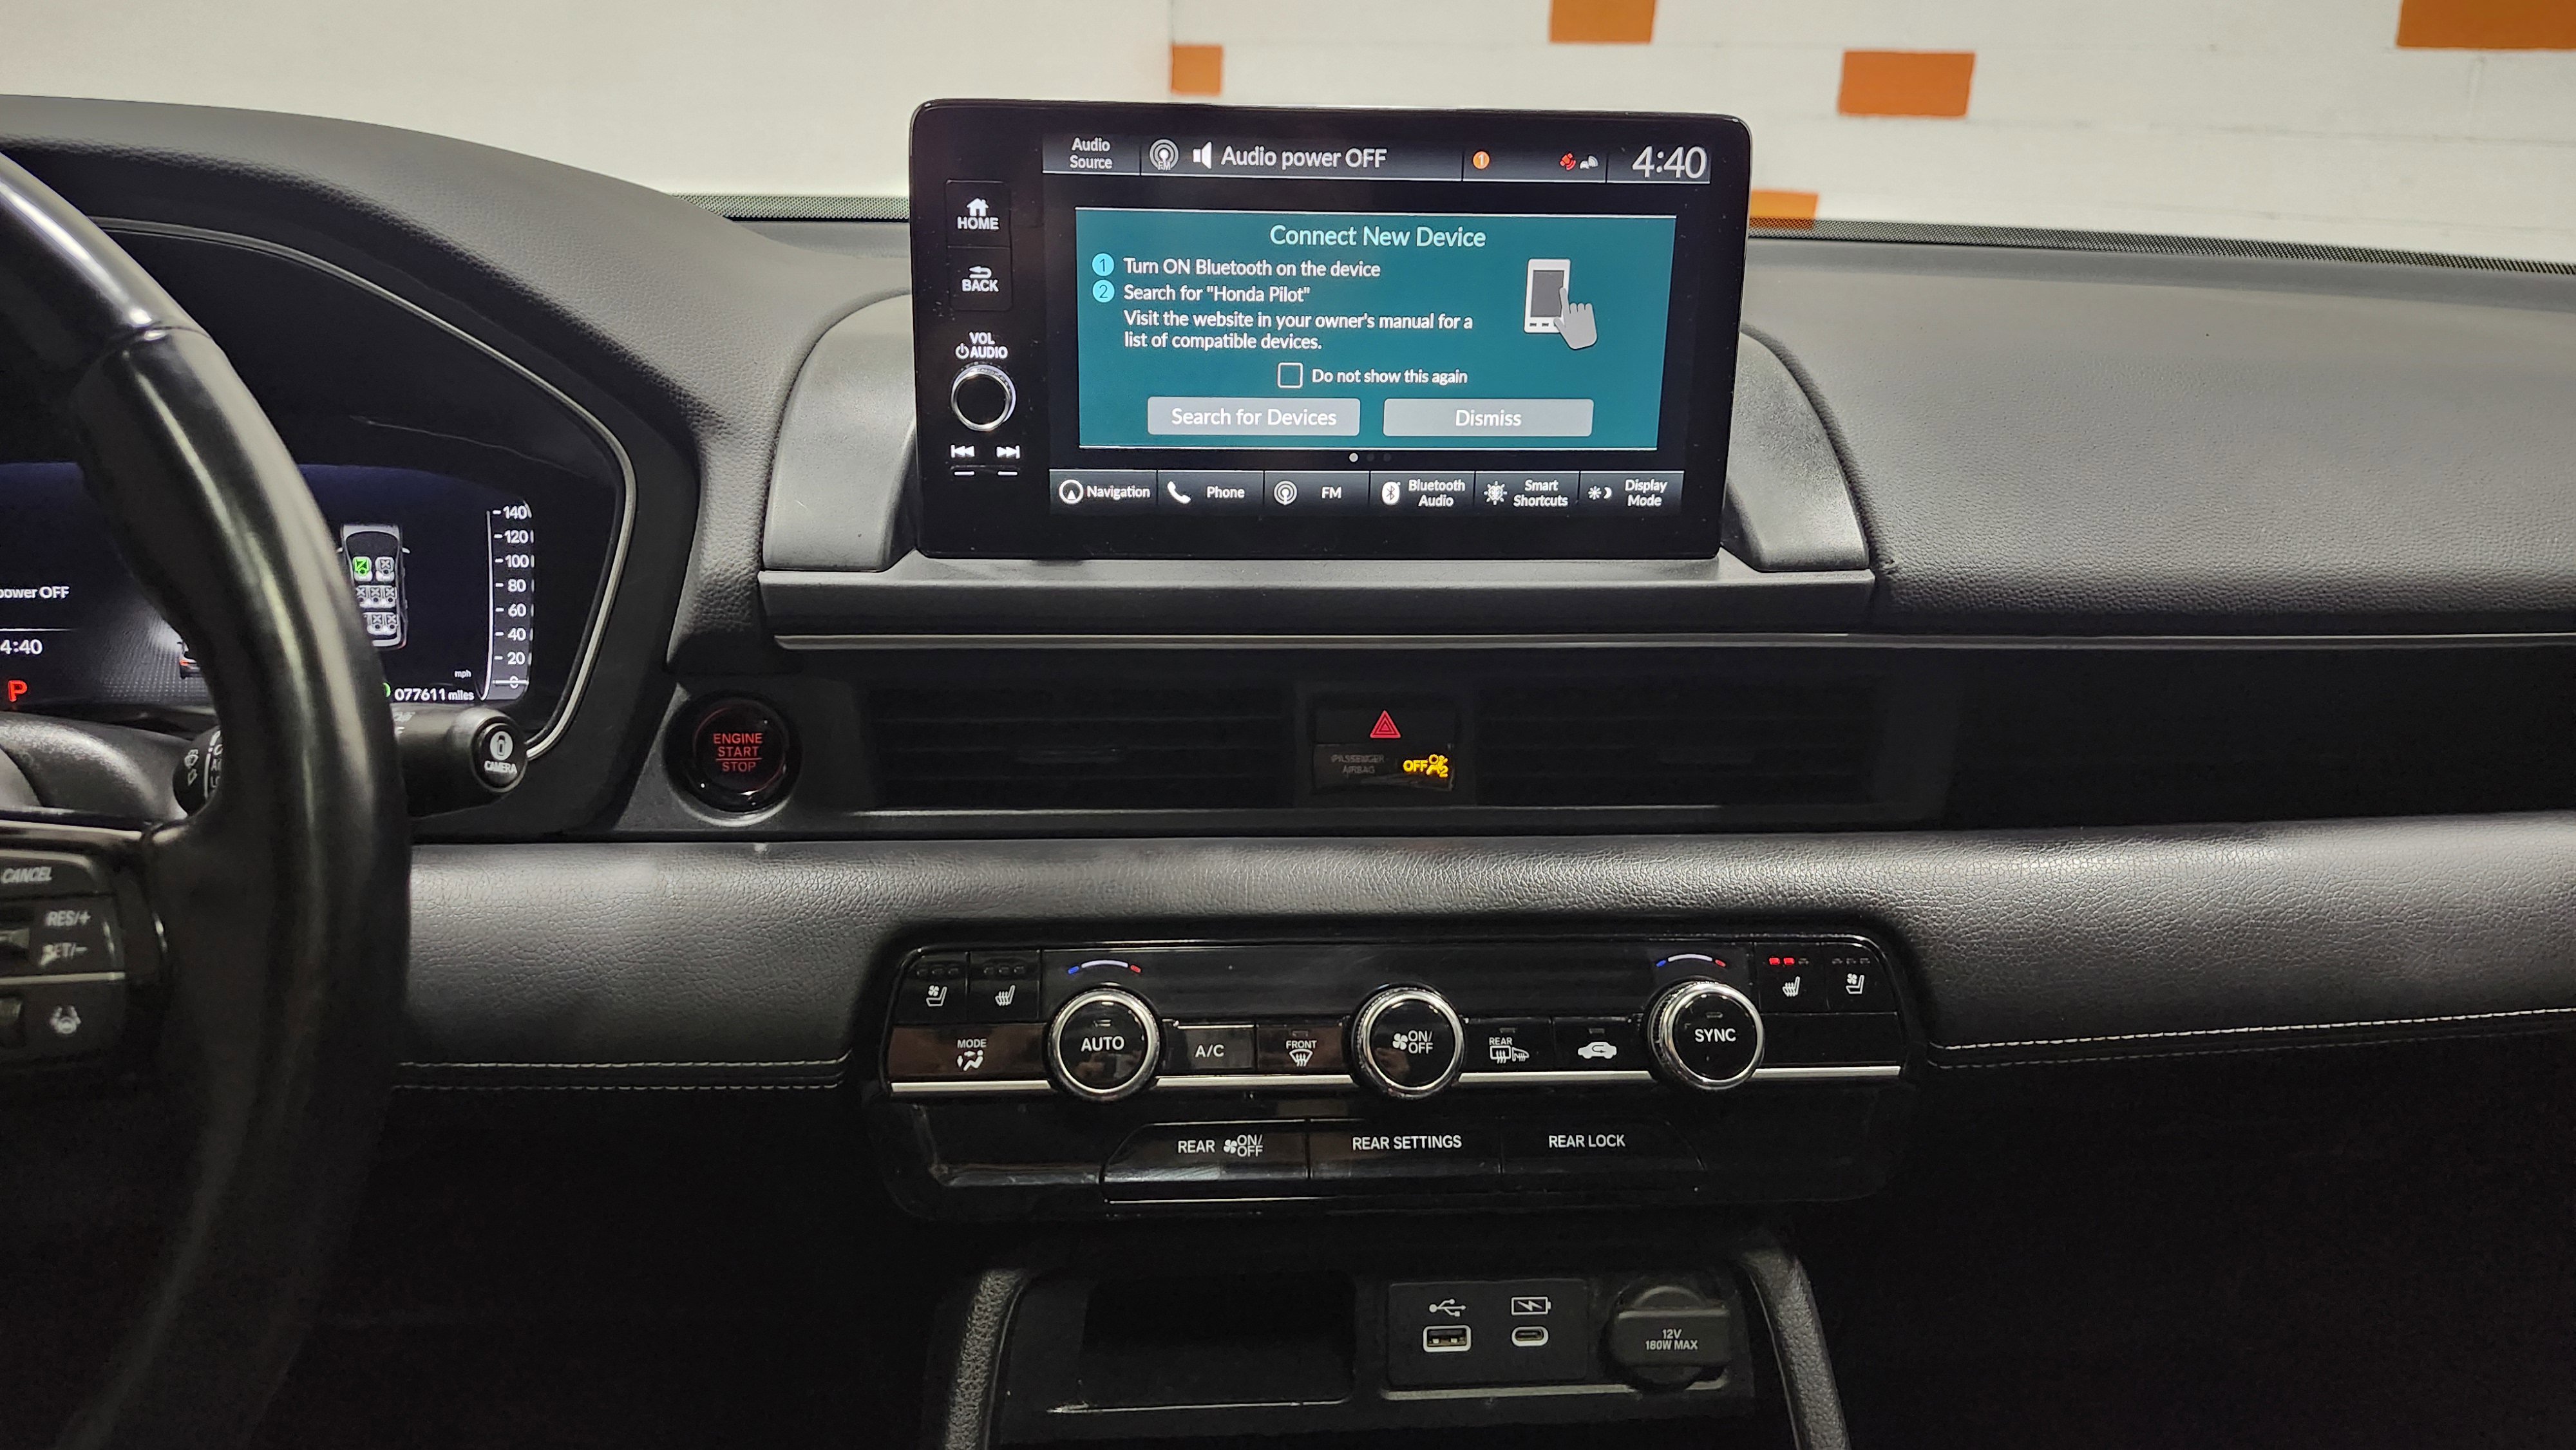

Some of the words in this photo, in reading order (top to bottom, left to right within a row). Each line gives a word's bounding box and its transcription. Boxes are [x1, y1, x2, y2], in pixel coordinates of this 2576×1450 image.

[1072, 138, 1110, 151] Audio
[1070, 155, 1112, 169] Source
[1221, 146, 1276, 165] Audio
[1282, 151, 1341, 170] power
[1345, 149, 1387, 167] OFF
[1633, 146, 1707, 178] 4:40
[958, 216, 999, 230] HOME
[1271, 225, 1357, 245] Connect
[1364, 226, 1410, 246] New
[1417, 227, 1486, 247] Device
[1123, 258, 1158, 274] Turn
[1164, 259, 1190, 274] ON
[1197, 259, 1272, 276] Bluetooth
[1276, 264, 1296, 276] on
[1301, 260, 1326, 276] the
[1331, 261, 1380, 276] device
[961, 279, 999, 292] BACK
[1124, 285, 1175, 300] Search
[1180, 285, 1203, 301] for
[1207, 286, 1264, 301] "Honda
[1270, 286, 1310, 302] Pilot"
[1124, 310, 1159, 326] Visit
[1163, 310, 1189, 326] the
[1193, 311, 1253, 327] website
[1258, 312, 1271, 327] in
[1276, 316, 1311, 330] your
[1315, 313, 1374, 328] owner's
[1379, 313, 1434, 328] manual
[1438, 314, 1461, 328] for
[1464, 317, 1472, 328] a
[969, 332, 995, 344] VOL
[1125, 332, 1148, 347] list
[1151, 333, 1168, 347] of
[1172, 333, 1256, 351] compatible
[1261, 335, 1321, 349] devices.
[970, 346, 1008, 359] AUDIO
[1312, 369, 1333, 382] Do
[1338, 370, 1361, 382] not
[1364, 369, 1401, 382] show
[1404, 369, 1428, 382] this
[1432, 370, 1467, 385] again
[1172, 408, 1231, 424] Search
[1236, 409, 1262, 425] for
[1268, 409, 1336, 425] Devices
[1456, 410, 1521, 426] Dismiss
[1086, 485, 1150, 498] Navigation
[1409, 479, 1465, 491] Bluetooth
[1525, 480, 1558, 491] Smart
[1625, 479, 1667, 493] Display
[1208, 486, 1244, 498] Phone
[1322, 487, 1341, 498] FM
[1419, 494, 1454, 507] Audio
[1513, 494, 1568, 507] Shortcuts
[1628, 494, 1662, 506] Mode
[504, 505, 526, 519] 140
[504, 530, 528, 543] 120
[506, 554, 529, 568] 100
[508, 579, 526, 592] 80
[39, 587, 69, 598] OFF
[508, 603, 526, 617] 60
[508, 628, 526, 641] 40
[0, 639, 43, 654] 4:40
[507, 652, 525, 664] 20
[455, 670, 471, 678] mph
[8, 681, 27, 702] P
[395, 688, 445, 701] 077611
[448, 690, 474, 700] miles
[713, 733, 762, 744] ENGINE
[718, 746, 759, 757] START
[484, 761, 517, 774] CAMERA
[722, 762, 756, 772] STOP
[1403, 760, 1428, 772] OFF
[1, 867, 52, 883] CANCEL
[1408, 1030, 1432, 1042] ON/
[1490, 1037, 1512, 1046] REAR
[1695, 1029, 1736, 1042] SYNC
[958, 1039, 986, 1048] MODE
[1081, 1036, 1124, 1051] AUTO
[1286, 1040, 1317, 1049] FRONT
[1408, 1042, 1433, 1054] OFF
[1195, 1045, 1224, 1057] A/C
[1179, 1140, 1215, 1153] REAR
[1237, 1135, 1264, 1145] ON/
[1353, 1136, 1389, 1150] REAR
[1394, 1135, 1461, 1149] SETTINGS
[1549, 1135, 1585, 1147] REAR
[1589, 1135, 1625, 1147] LOCK
[1237, 1145, 1264, 1157] OFF
[1663, 1329, 1681, 1339] 12V
[1646, 1340, 1672, 1350] 180W
[1674, 1340, 1698, 1350] MAX
